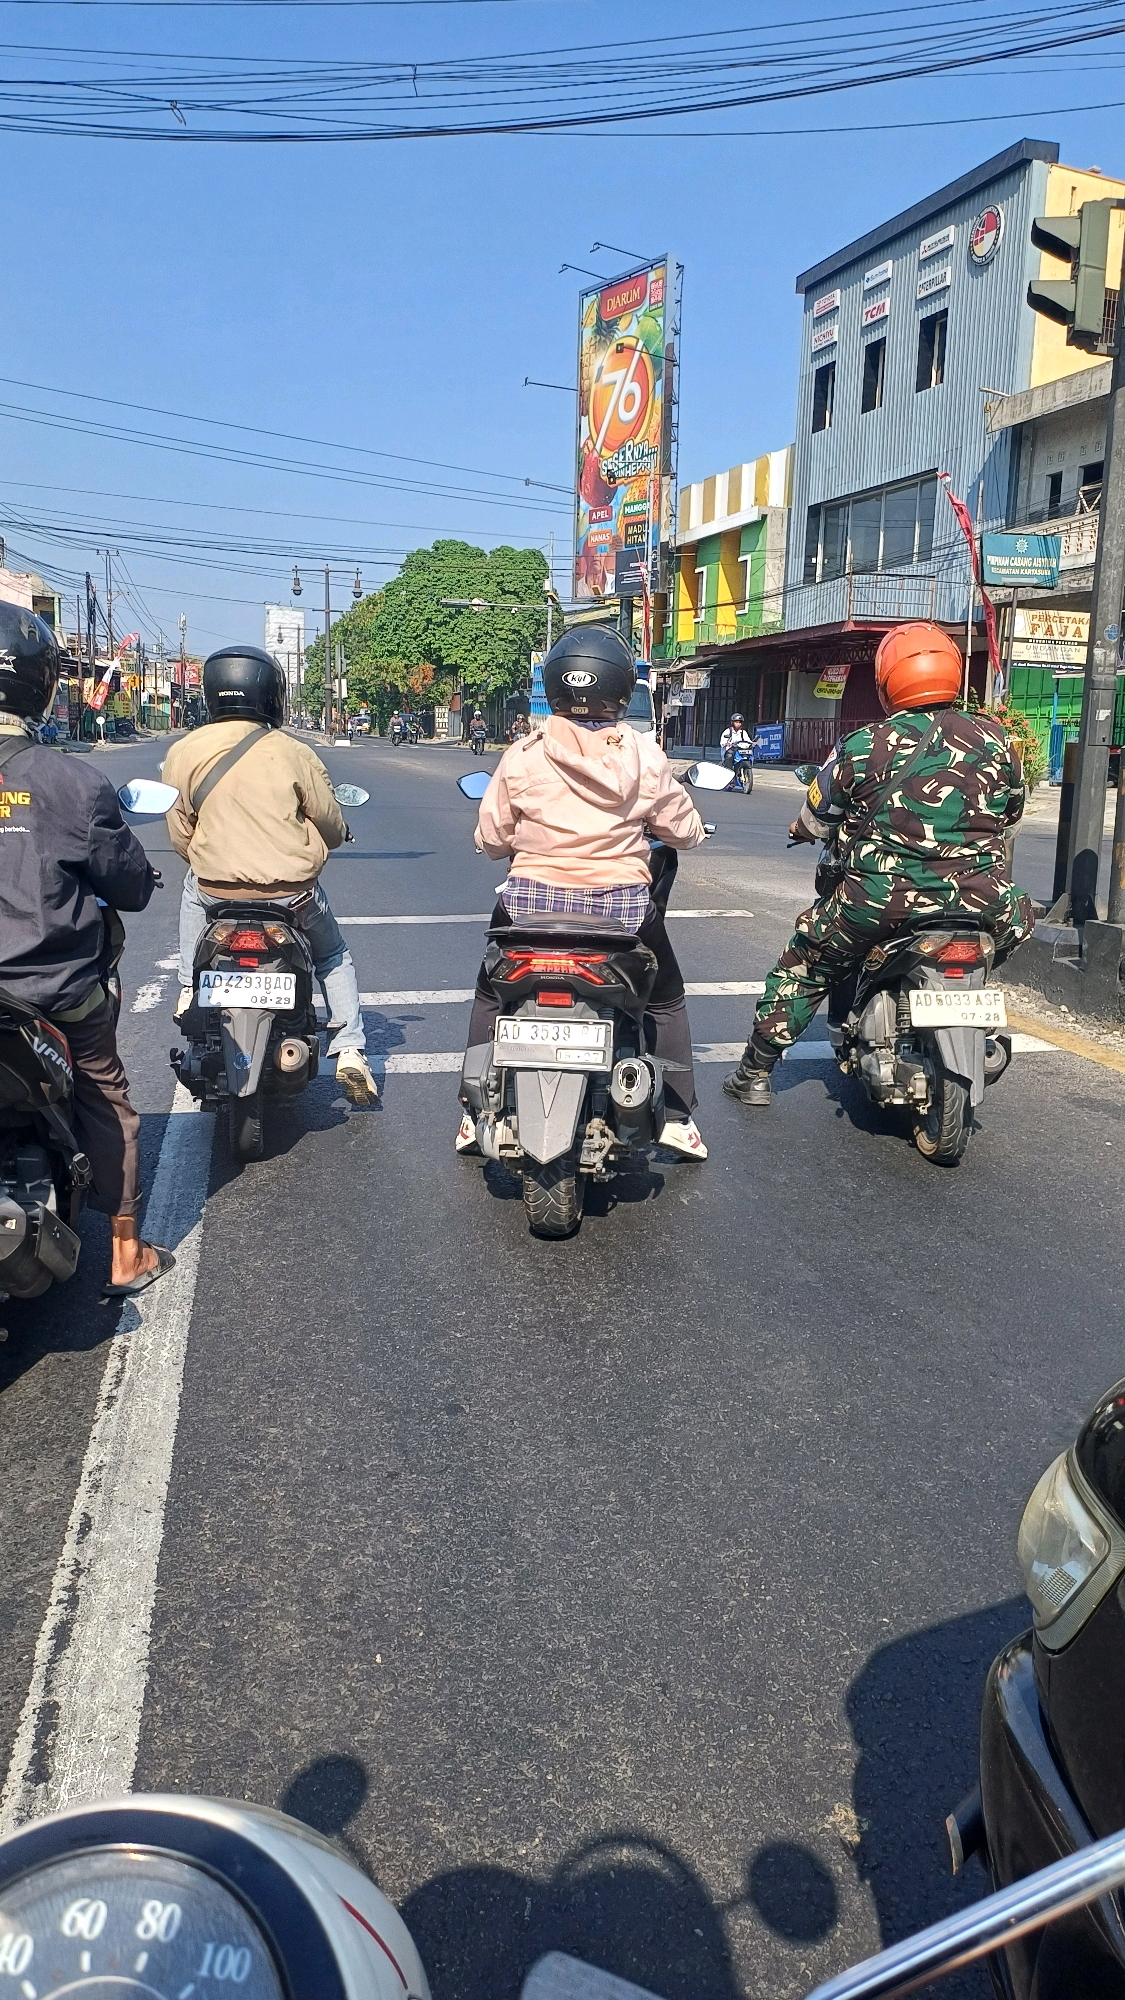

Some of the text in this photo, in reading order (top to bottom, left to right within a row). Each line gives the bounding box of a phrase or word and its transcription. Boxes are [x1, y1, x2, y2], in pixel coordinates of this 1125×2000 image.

[864, 301, 886, 322] TCM
[595, 339, 643, 450] 76
[591, 510, 609, 520] APEL
[590, 533, 610, 543] NANAS
[1010, 556, 1033, 567] CABANG
[915, 993, 932, 1007] AD
[975, 992, 1001, 1006] ASF
[500, 1024, 520, 1040] AD
[530, 1024, 571, 1041] 3539
[61, 1898, 108, 1941] 60
[135, 1899, 182, 1943] 80
[199, 1942, 252, 1983] 100
